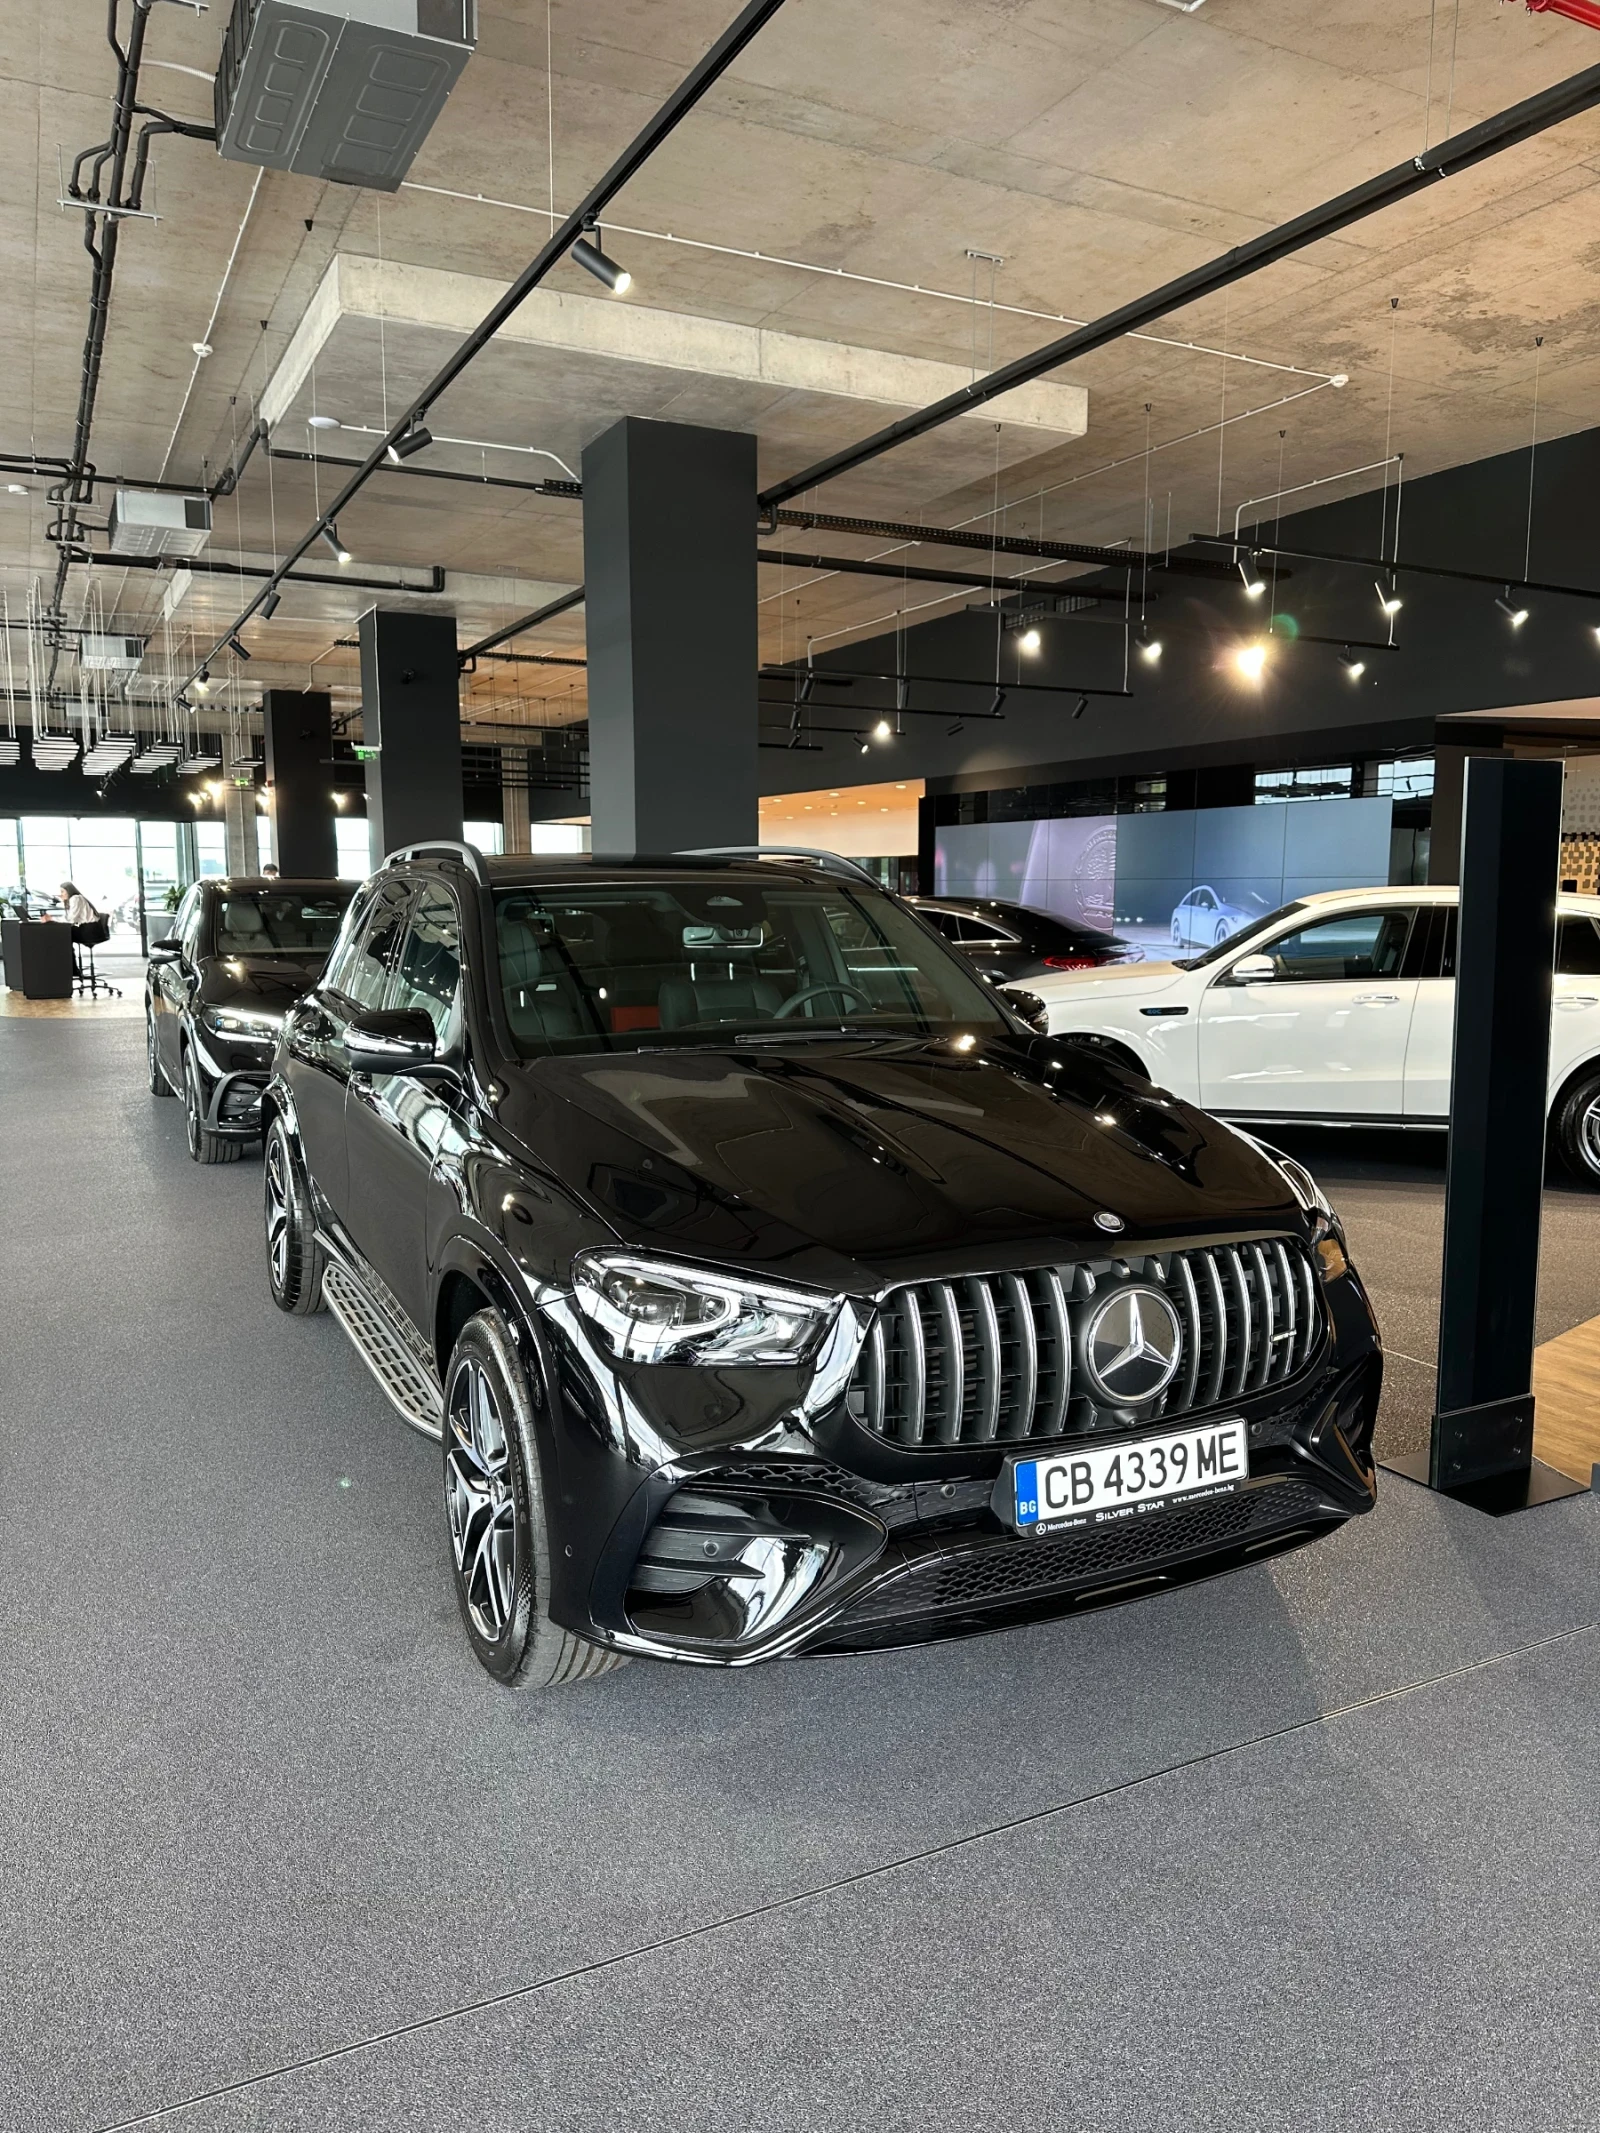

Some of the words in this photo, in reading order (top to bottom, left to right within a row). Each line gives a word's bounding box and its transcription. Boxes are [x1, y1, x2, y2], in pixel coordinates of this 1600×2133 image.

[1045, 1461, 1094, 1509] CB
[1104, 1443, 1188, 1497] 4339
[1196, 1430, 1239, 1479] ME
[1020, 1500, 1037, 1515] BG
[1047, 1518, 1087, 1531] Mercedes-Benz
[1095, 1507, 1134, 1522] SILVER
[1137, 1500, 1165, 1513] STAR
[1172, 1483, 1235, 1504] www.mercedes-benz.bg
